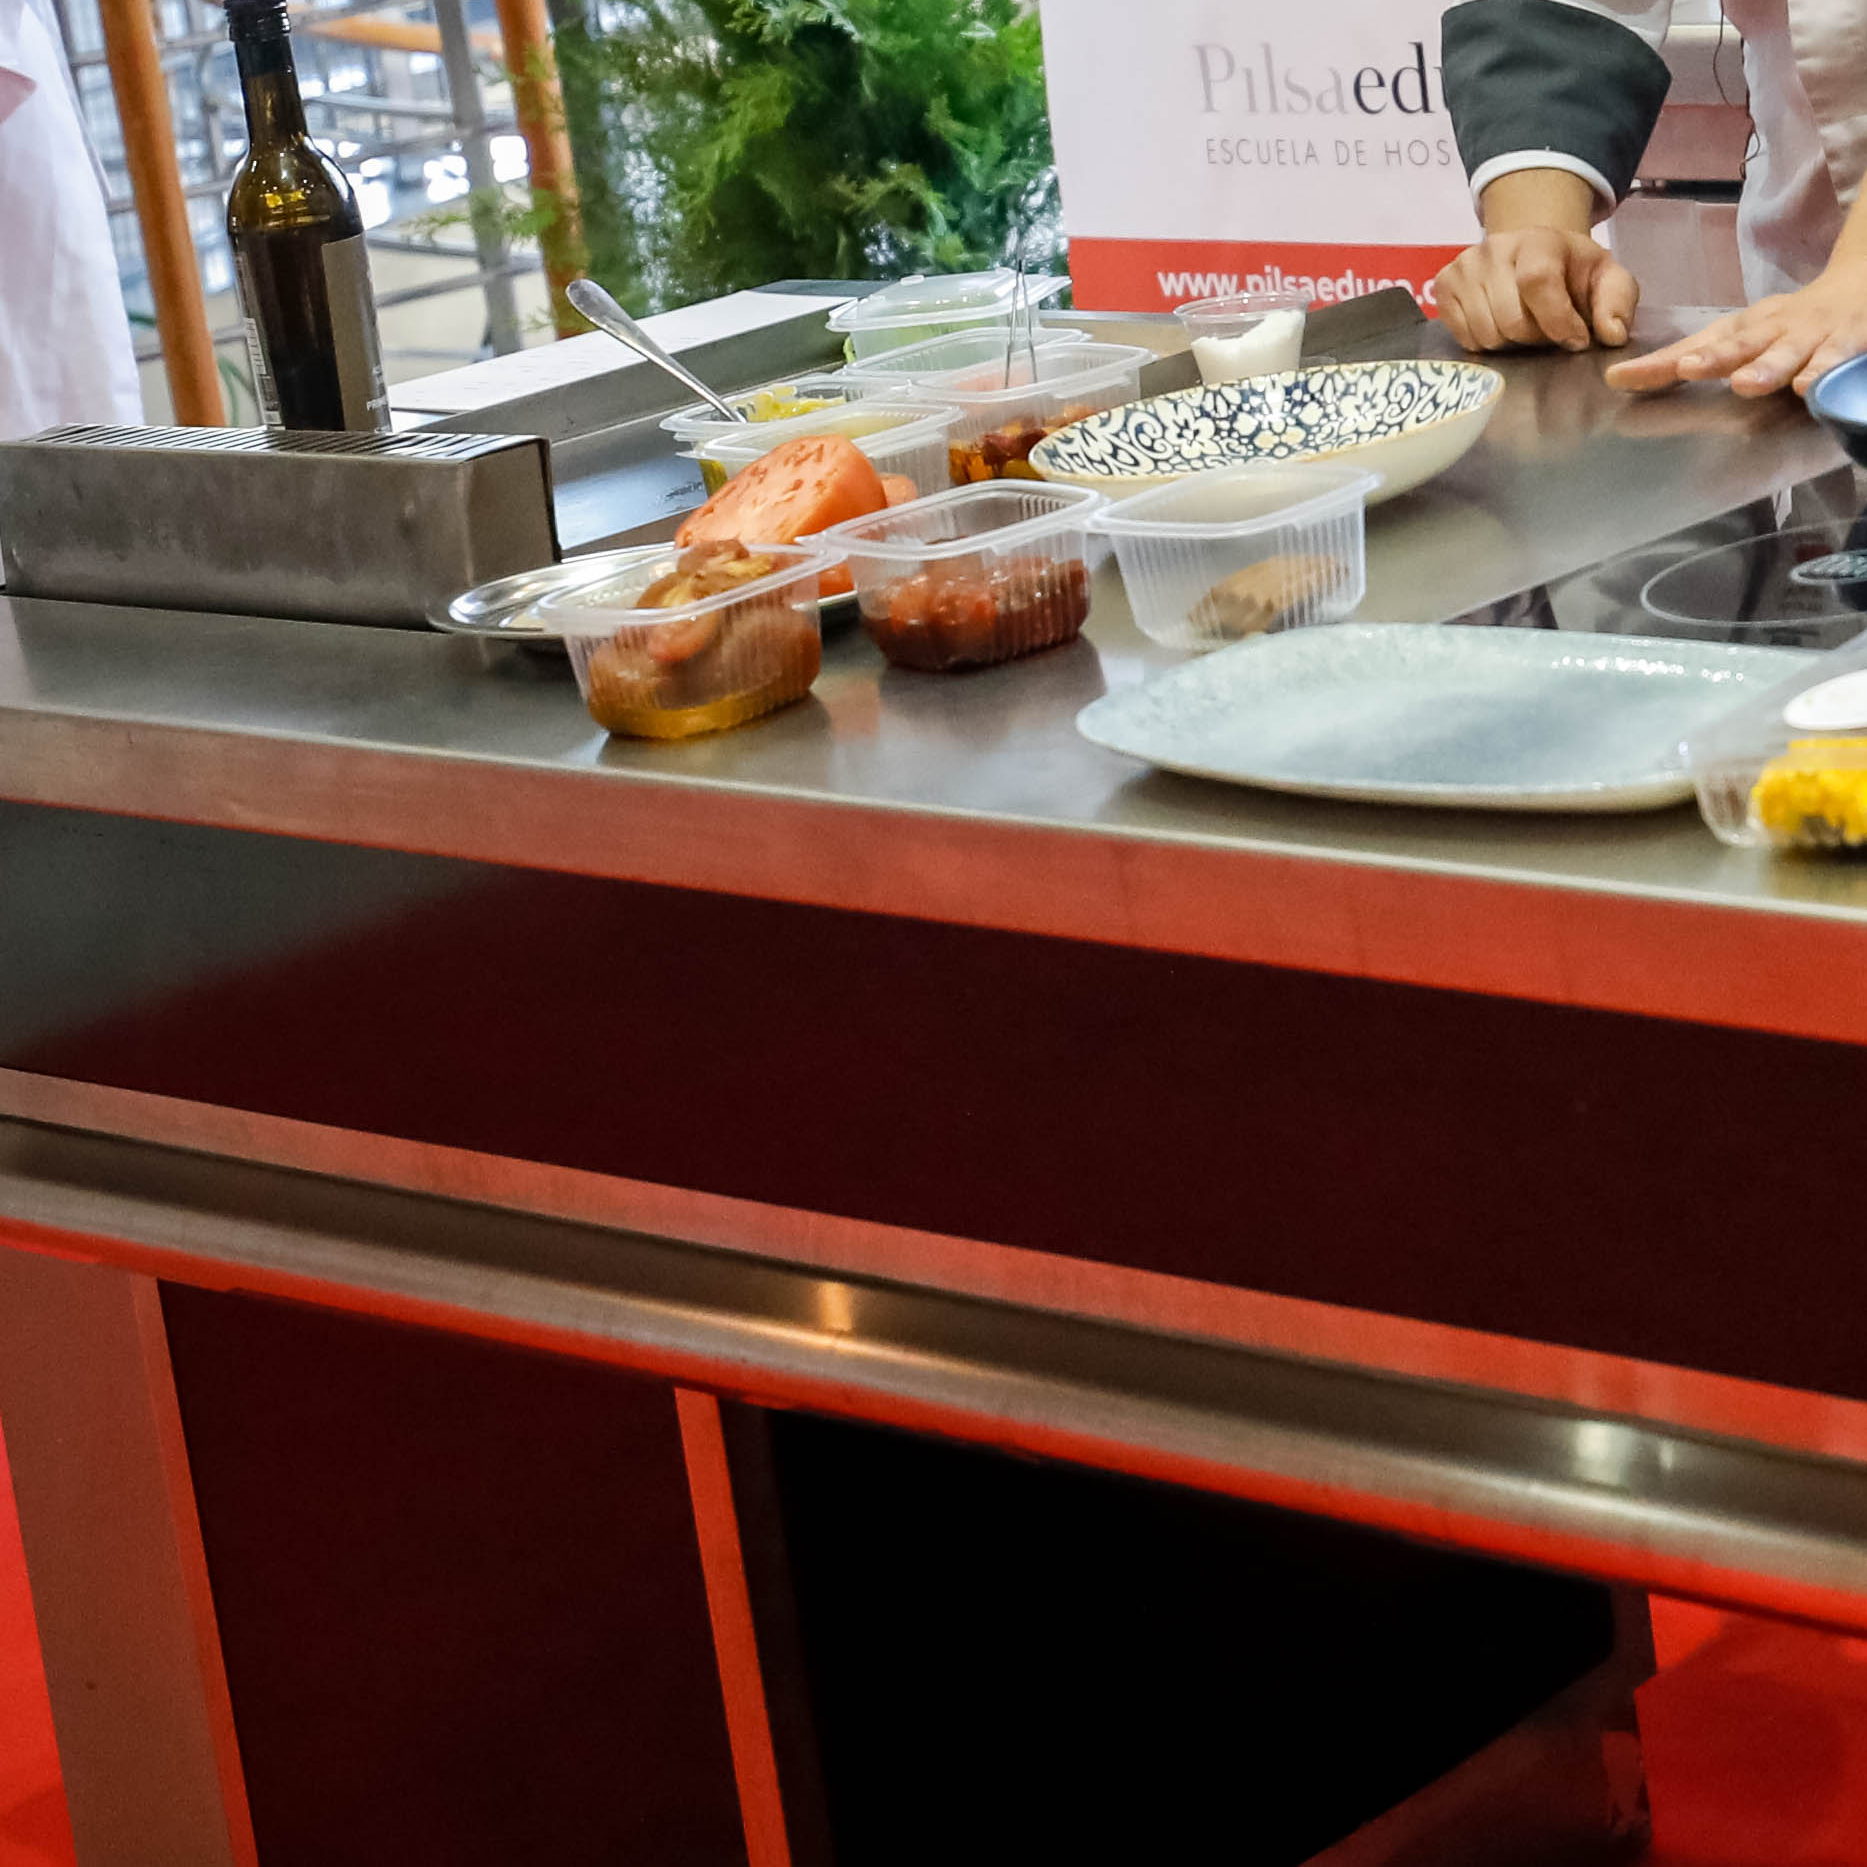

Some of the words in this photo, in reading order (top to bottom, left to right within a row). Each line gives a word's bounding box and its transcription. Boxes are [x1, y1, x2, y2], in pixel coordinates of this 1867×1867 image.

[1206, 138, 1318, 166] ESCUELA
[1335, 138, 1367, 166] DE
[1384, 138, 1450, 166] HOS
